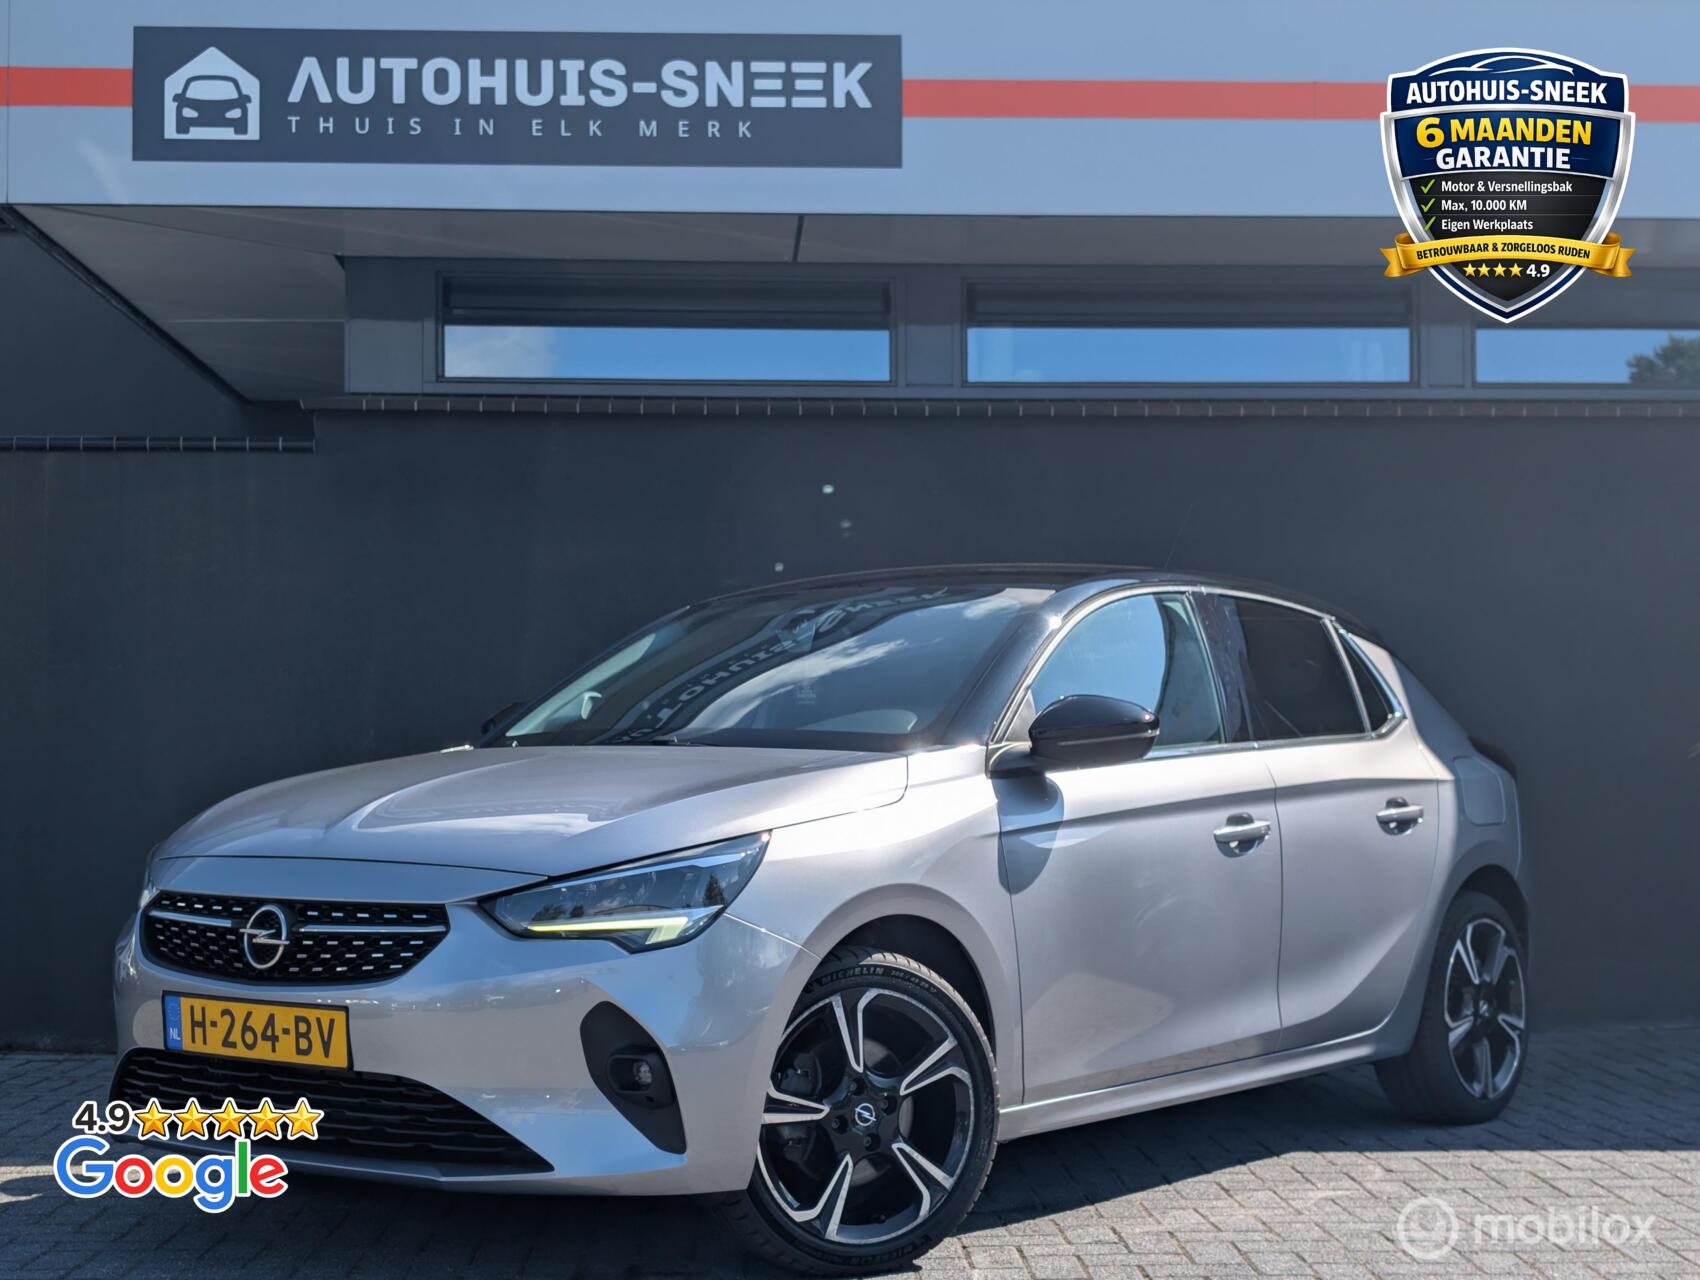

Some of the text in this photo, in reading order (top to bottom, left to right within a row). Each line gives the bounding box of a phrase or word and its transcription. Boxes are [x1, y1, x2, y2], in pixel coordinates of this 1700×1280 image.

[287, 55, 872, 109] AUTOHUIS-SNEEK
[287, 115, 752, 139] THUIS IN ELK MERK
[822, 966, 884, 987] MICHELIN
[169, 1004, 336, 1059] NL H-264-BV
